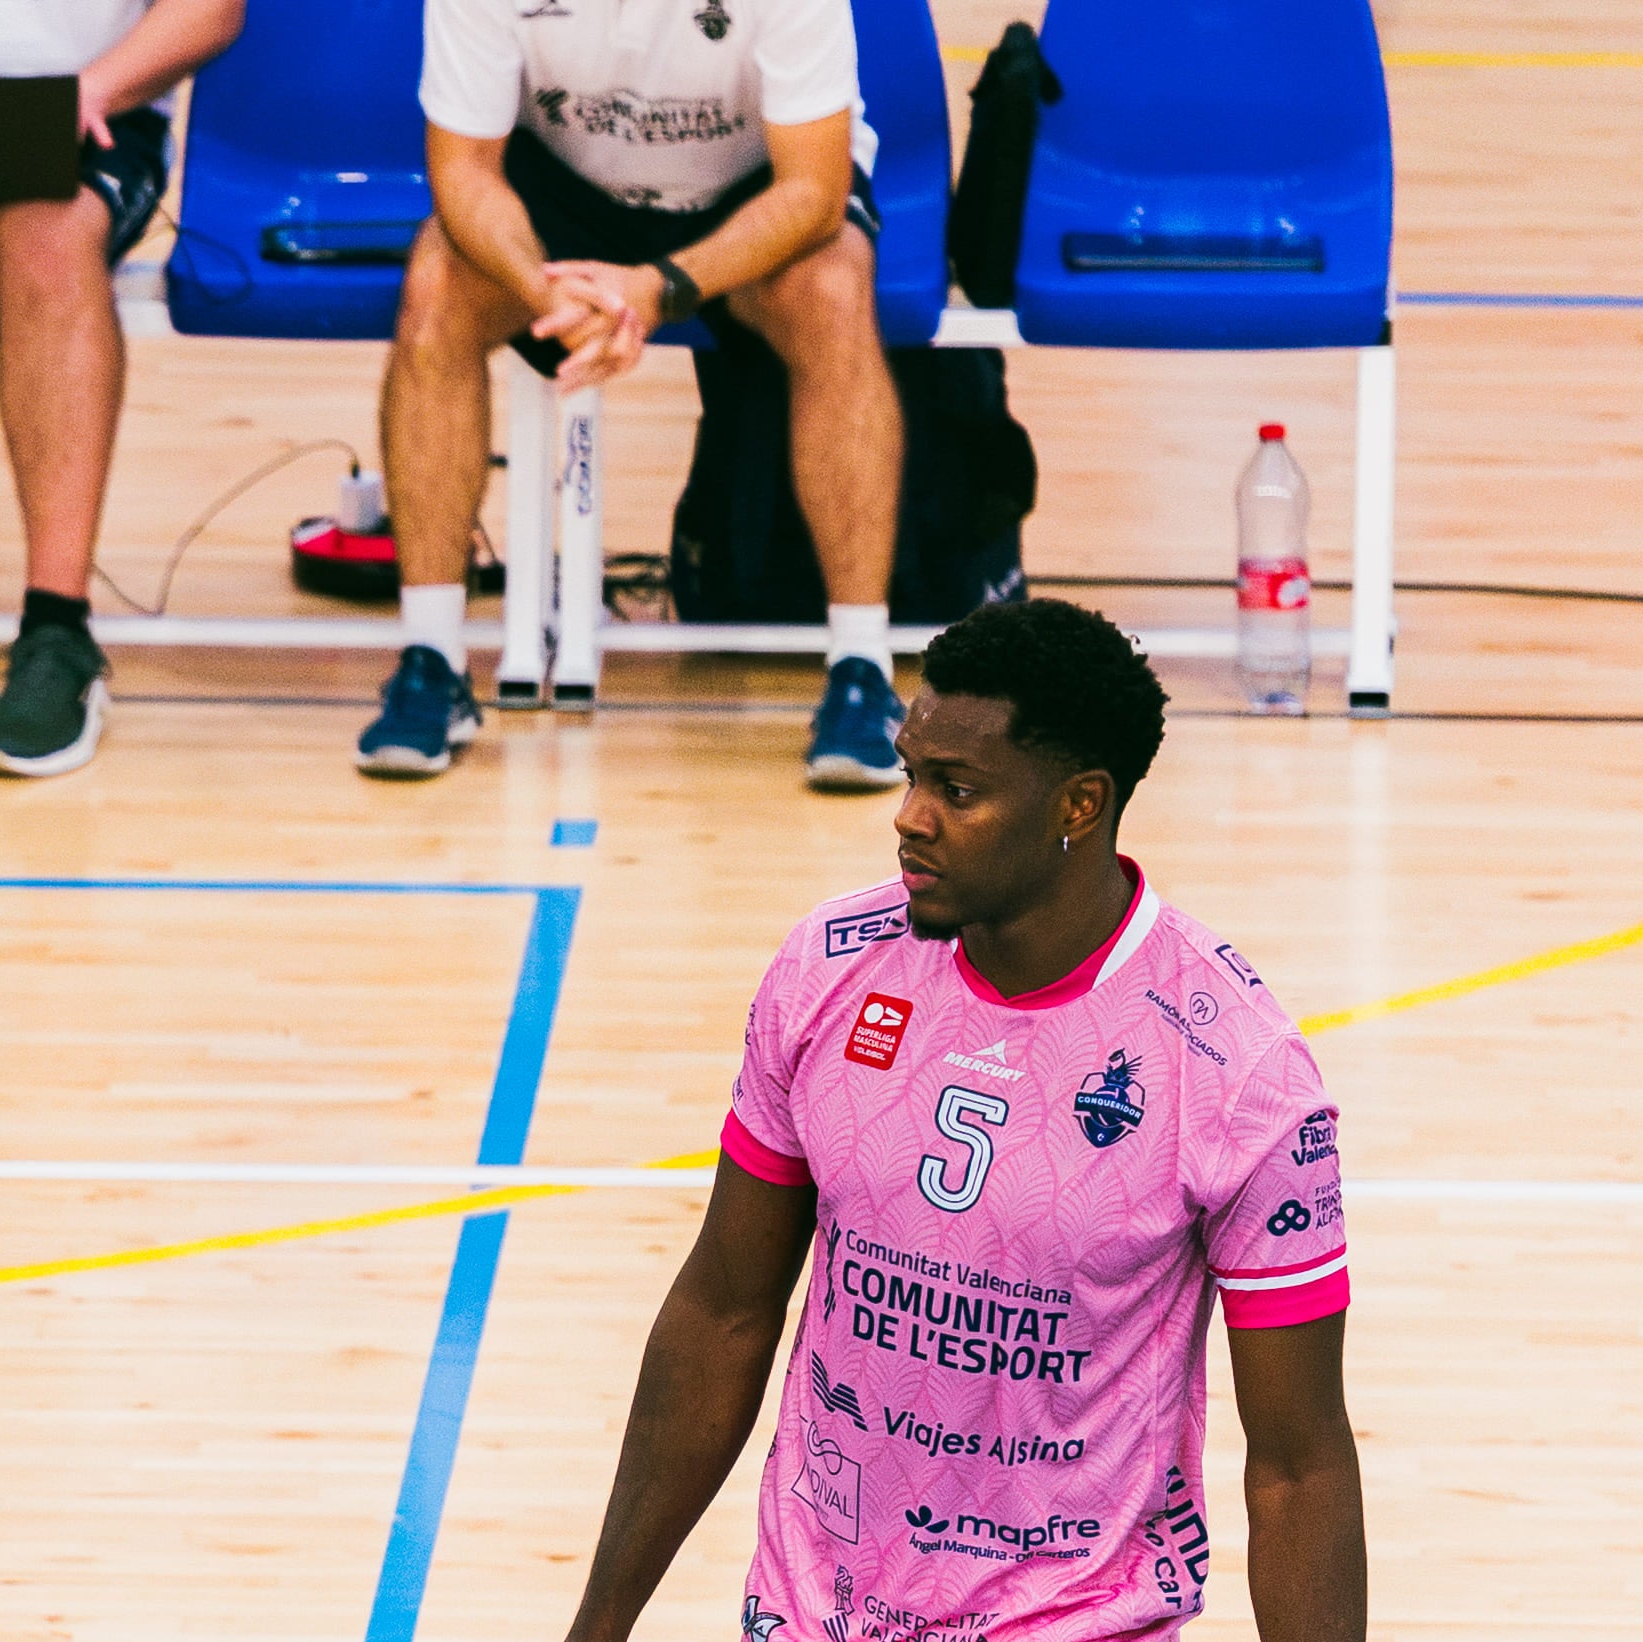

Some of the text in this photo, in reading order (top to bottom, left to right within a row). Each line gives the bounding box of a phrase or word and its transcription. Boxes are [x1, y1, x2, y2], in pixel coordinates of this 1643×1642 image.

[852, 1035, 894, 1053] MASCULINA
[855, 1026, 896, 1045] SUPERLIGA
[943, 1051, 1026, 1082] MERCURY
[1077, 1094, 1142, 1119] CONQUERIDOR
[917, 1083, 1008, 1213] 5
[846, 1228, 1072, 1305] Comunitat Valenciana
[843, 1259, 1068, 1346] COMUNITAT
[853, 1303, 1092, 1384] DE L'ESPORT
[883, 1406, 1084, 1467] Viajes Alsina
[943, 1539, 1007, 1560] Marquina
[957, 1514, 1101, 1551] mapfre
